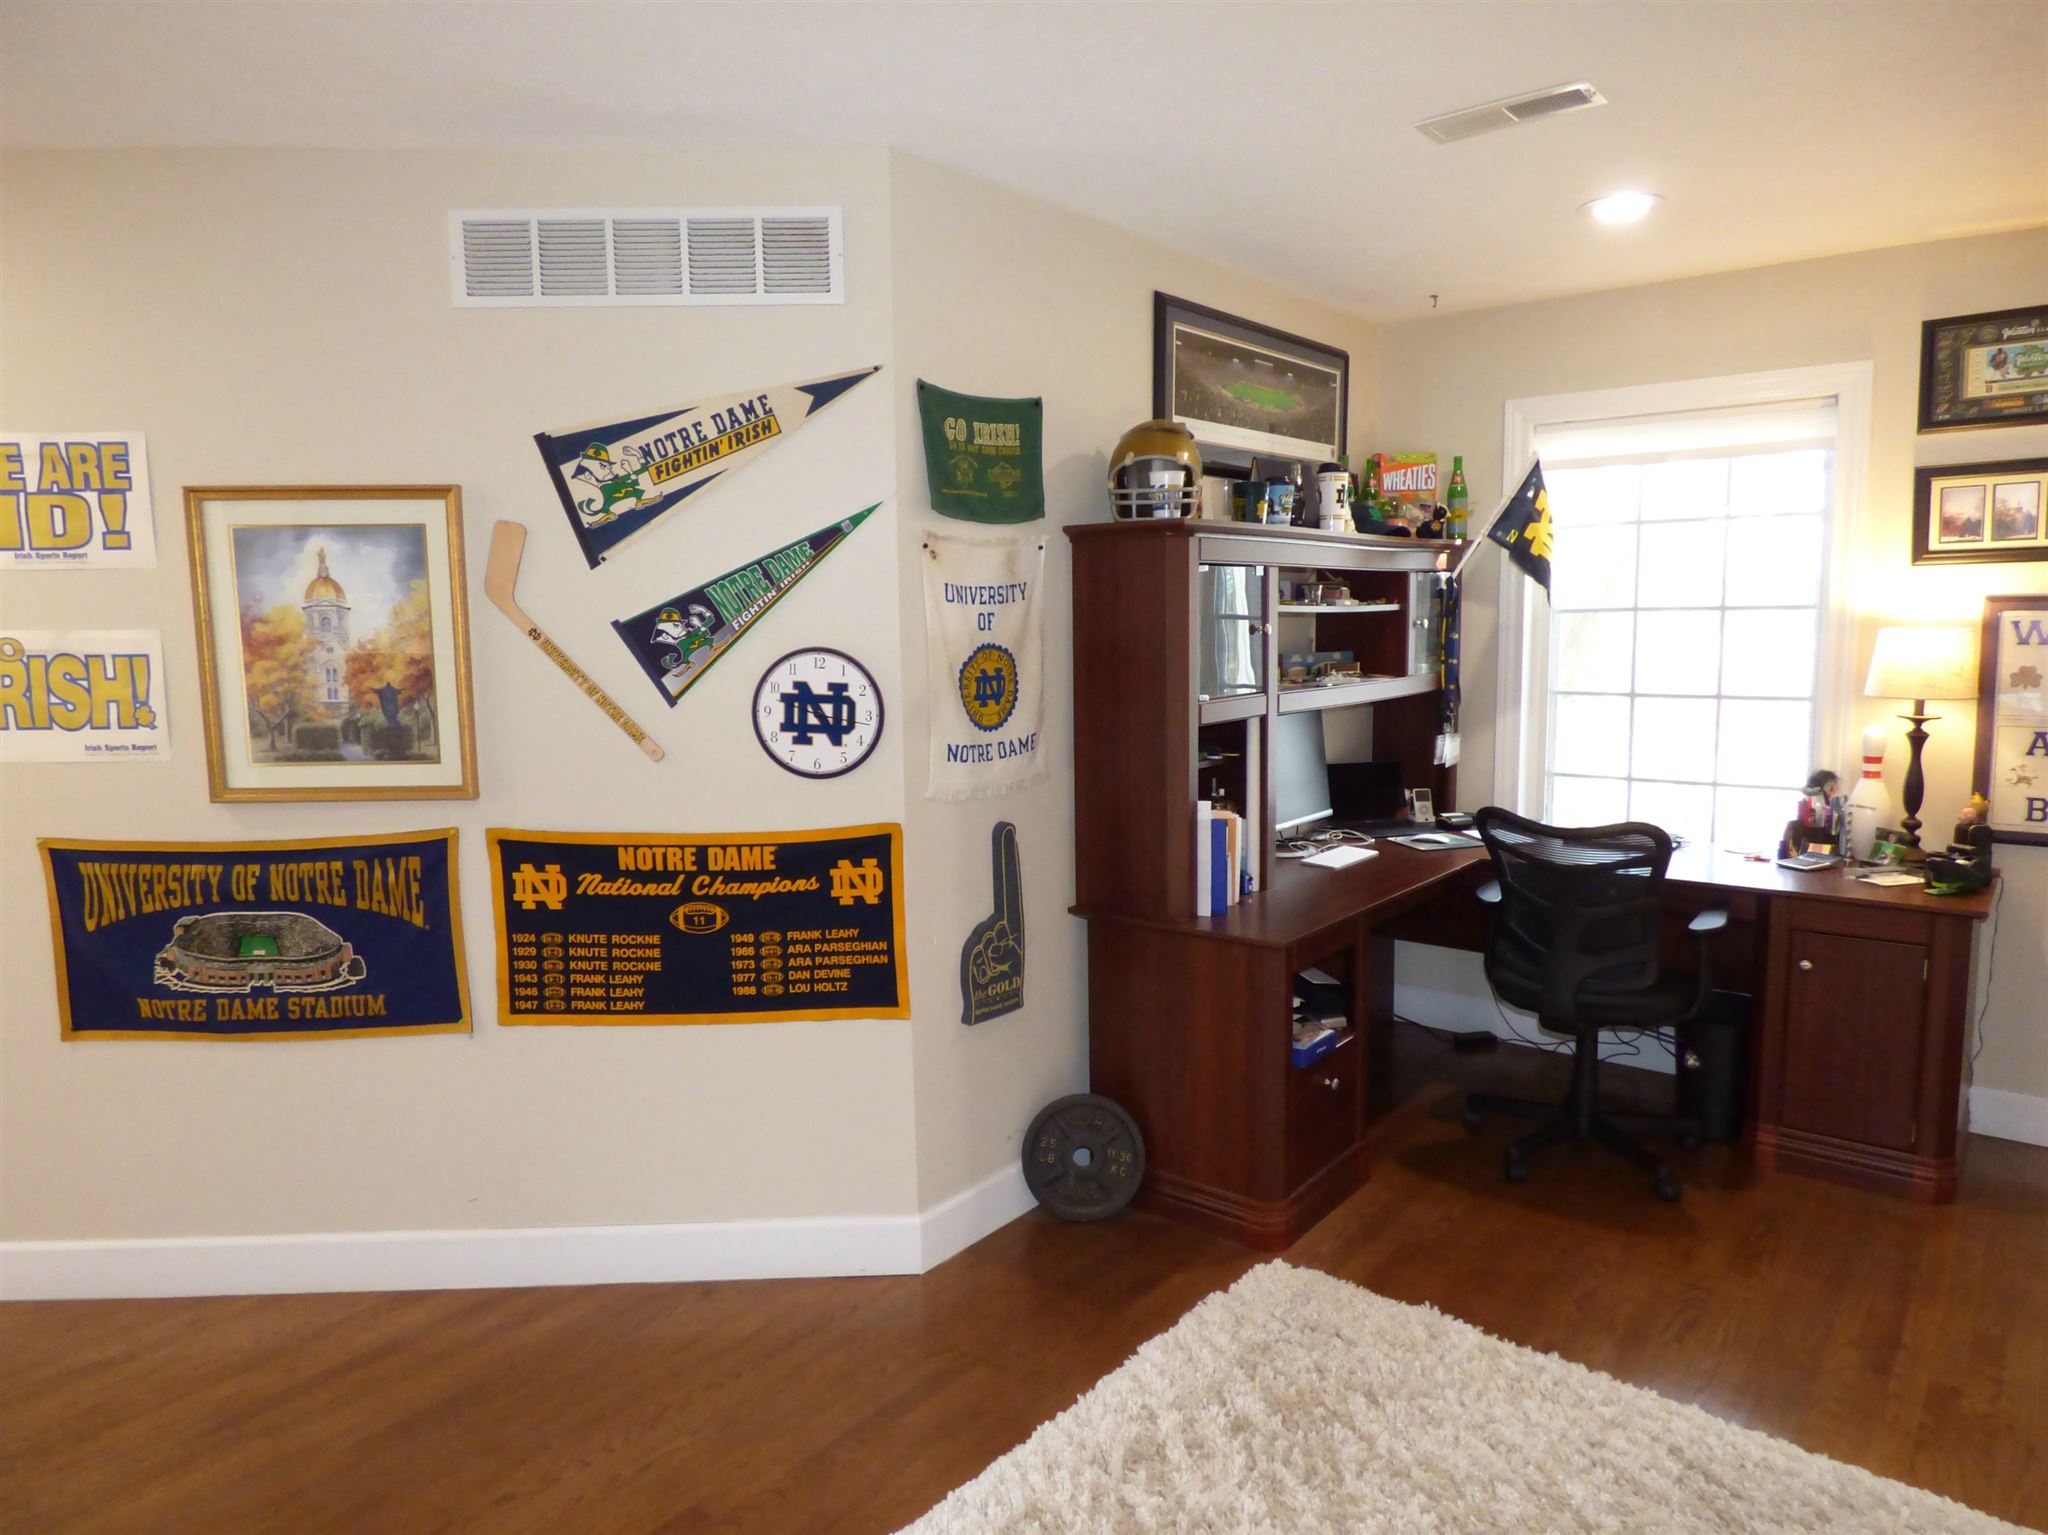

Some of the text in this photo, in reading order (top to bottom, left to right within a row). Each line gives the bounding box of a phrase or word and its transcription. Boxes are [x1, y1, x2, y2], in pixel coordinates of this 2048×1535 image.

[639, 394, 774, 463] NOTRE DAME
[944, 417, 1020, 446] GO IRISH!
[655, 416, 773, 481] FIGHTIN' IRISH
[38, 441, 133, 491] ARE
[1382, 463, 1436, 491] WHEATIES
[35, 552, 60, 560] Sports
[62, 551, 89, 560] Report
[704, 541, 815, 625] NOTRE DAME
[944, 582, 1027, 606] UNIVERSITY
[731, 588, 778, 631] FIGHTIN'
[977, 612, 995, 631] OF
[814, 657, 826, 669] 12
[789, 664, 796, 675] 11
[541, 639, 590, 687] UNIVERSITY
[585, 683, 600, 697] OF
[596, 695, 624, 721] NOTRE
[770, 682, 779, 693] 10
[859, 685, 866, 696] 2
[764, 706, 771, 717] 9
[865, 710, 872, 721] 3
[770, 732, 778, 743] 8
[857, 735, 863, 746] 4
[104, 744, 129, 752] Sports
[131, 744, 157, 752] Report
[947, 733, 1036, 763] NOTRE DAME
[789, 750, 795, 761] 7
[840, 752, 847, 763] 5
[814, 758, 821, 769] 6
[617, 846, 778, 871] NOTRE DAME
[576, 873, 821, 900] National Champions
[78, 856, 427, 933] UNIVERSITY OF NOTRE DAME
[692, 916, 705, 926] 11
[512, 934, 536, 943] 1924
[568, 934, 607, 944] KNUTE
[611, 935, 661, 944] ROCKNE
[730, 934, 754, 943] 1949
[787, 930, 822, 940] FRANK
[825, 929, 859, 939] LEAHY
[512, 947, 536, 956] 1929
[569, 948, 608, 957] KNUTE
[612, 948, 661, 958] ROCKNE
[787, 944, 811, 954] ARA
[814, 941, 887, 952] PARSEGHIAN
[513, 960, 537, 969] 1930
[569, 961, 608, 970] KNUTE
[612, 961, 662, 971] ROCKNE
[731, 960, 755, 969] 1973
[788, 957, 812, 967] ARA
[815, 955, 888, 966] PARSEGHIAN
[514, 974, 537, 983] 1943
[570, 974, 606, 984] FRANK
[609, 975, 643, 984] LEAHY
[731, 973, 755, 983] 1977
[788, 970, 810, 980] DAN
[814, 968, 851, 979] DEVINE
[570, 987, 607, 997] FRANK
[610, 988, 644, 998] LEAHY
[789, 983, 810, 993] LOU
[814, 982, 848, 992] HOLTZ
[136, 994, 387, 1021] NOTRE DAME STADIUM
[514, 1001, 538, 1010] 1947
[571, 1001, 607, 1010] FRANK
[610, 1001, 645, 1011] LEAHY
[1040, 1137, 1056, 1148] 25
